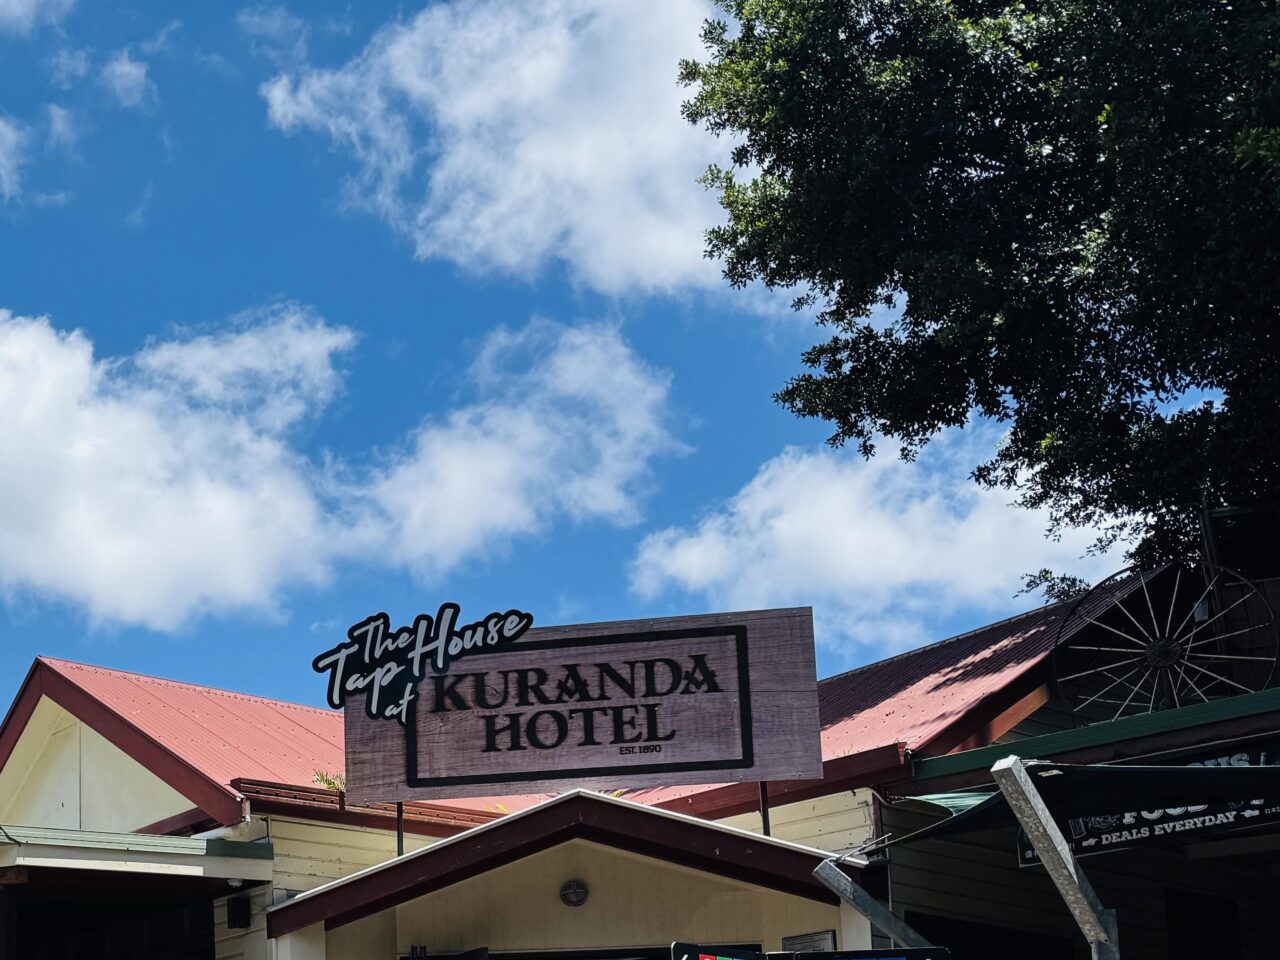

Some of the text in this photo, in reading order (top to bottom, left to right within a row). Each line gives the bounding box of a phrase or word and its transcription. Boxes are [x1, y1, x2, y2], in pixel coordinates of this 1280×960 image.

[318, 608, 527, 713] Tap House
[354, 619, 414, 663] The
[384, 683, 414, 723] at
[429, 655, 723, 713] KURANDA
[481, 704, 676, 752] HOTEL
[1101, 811, 1238, 845] DEALS EVERYDAY
